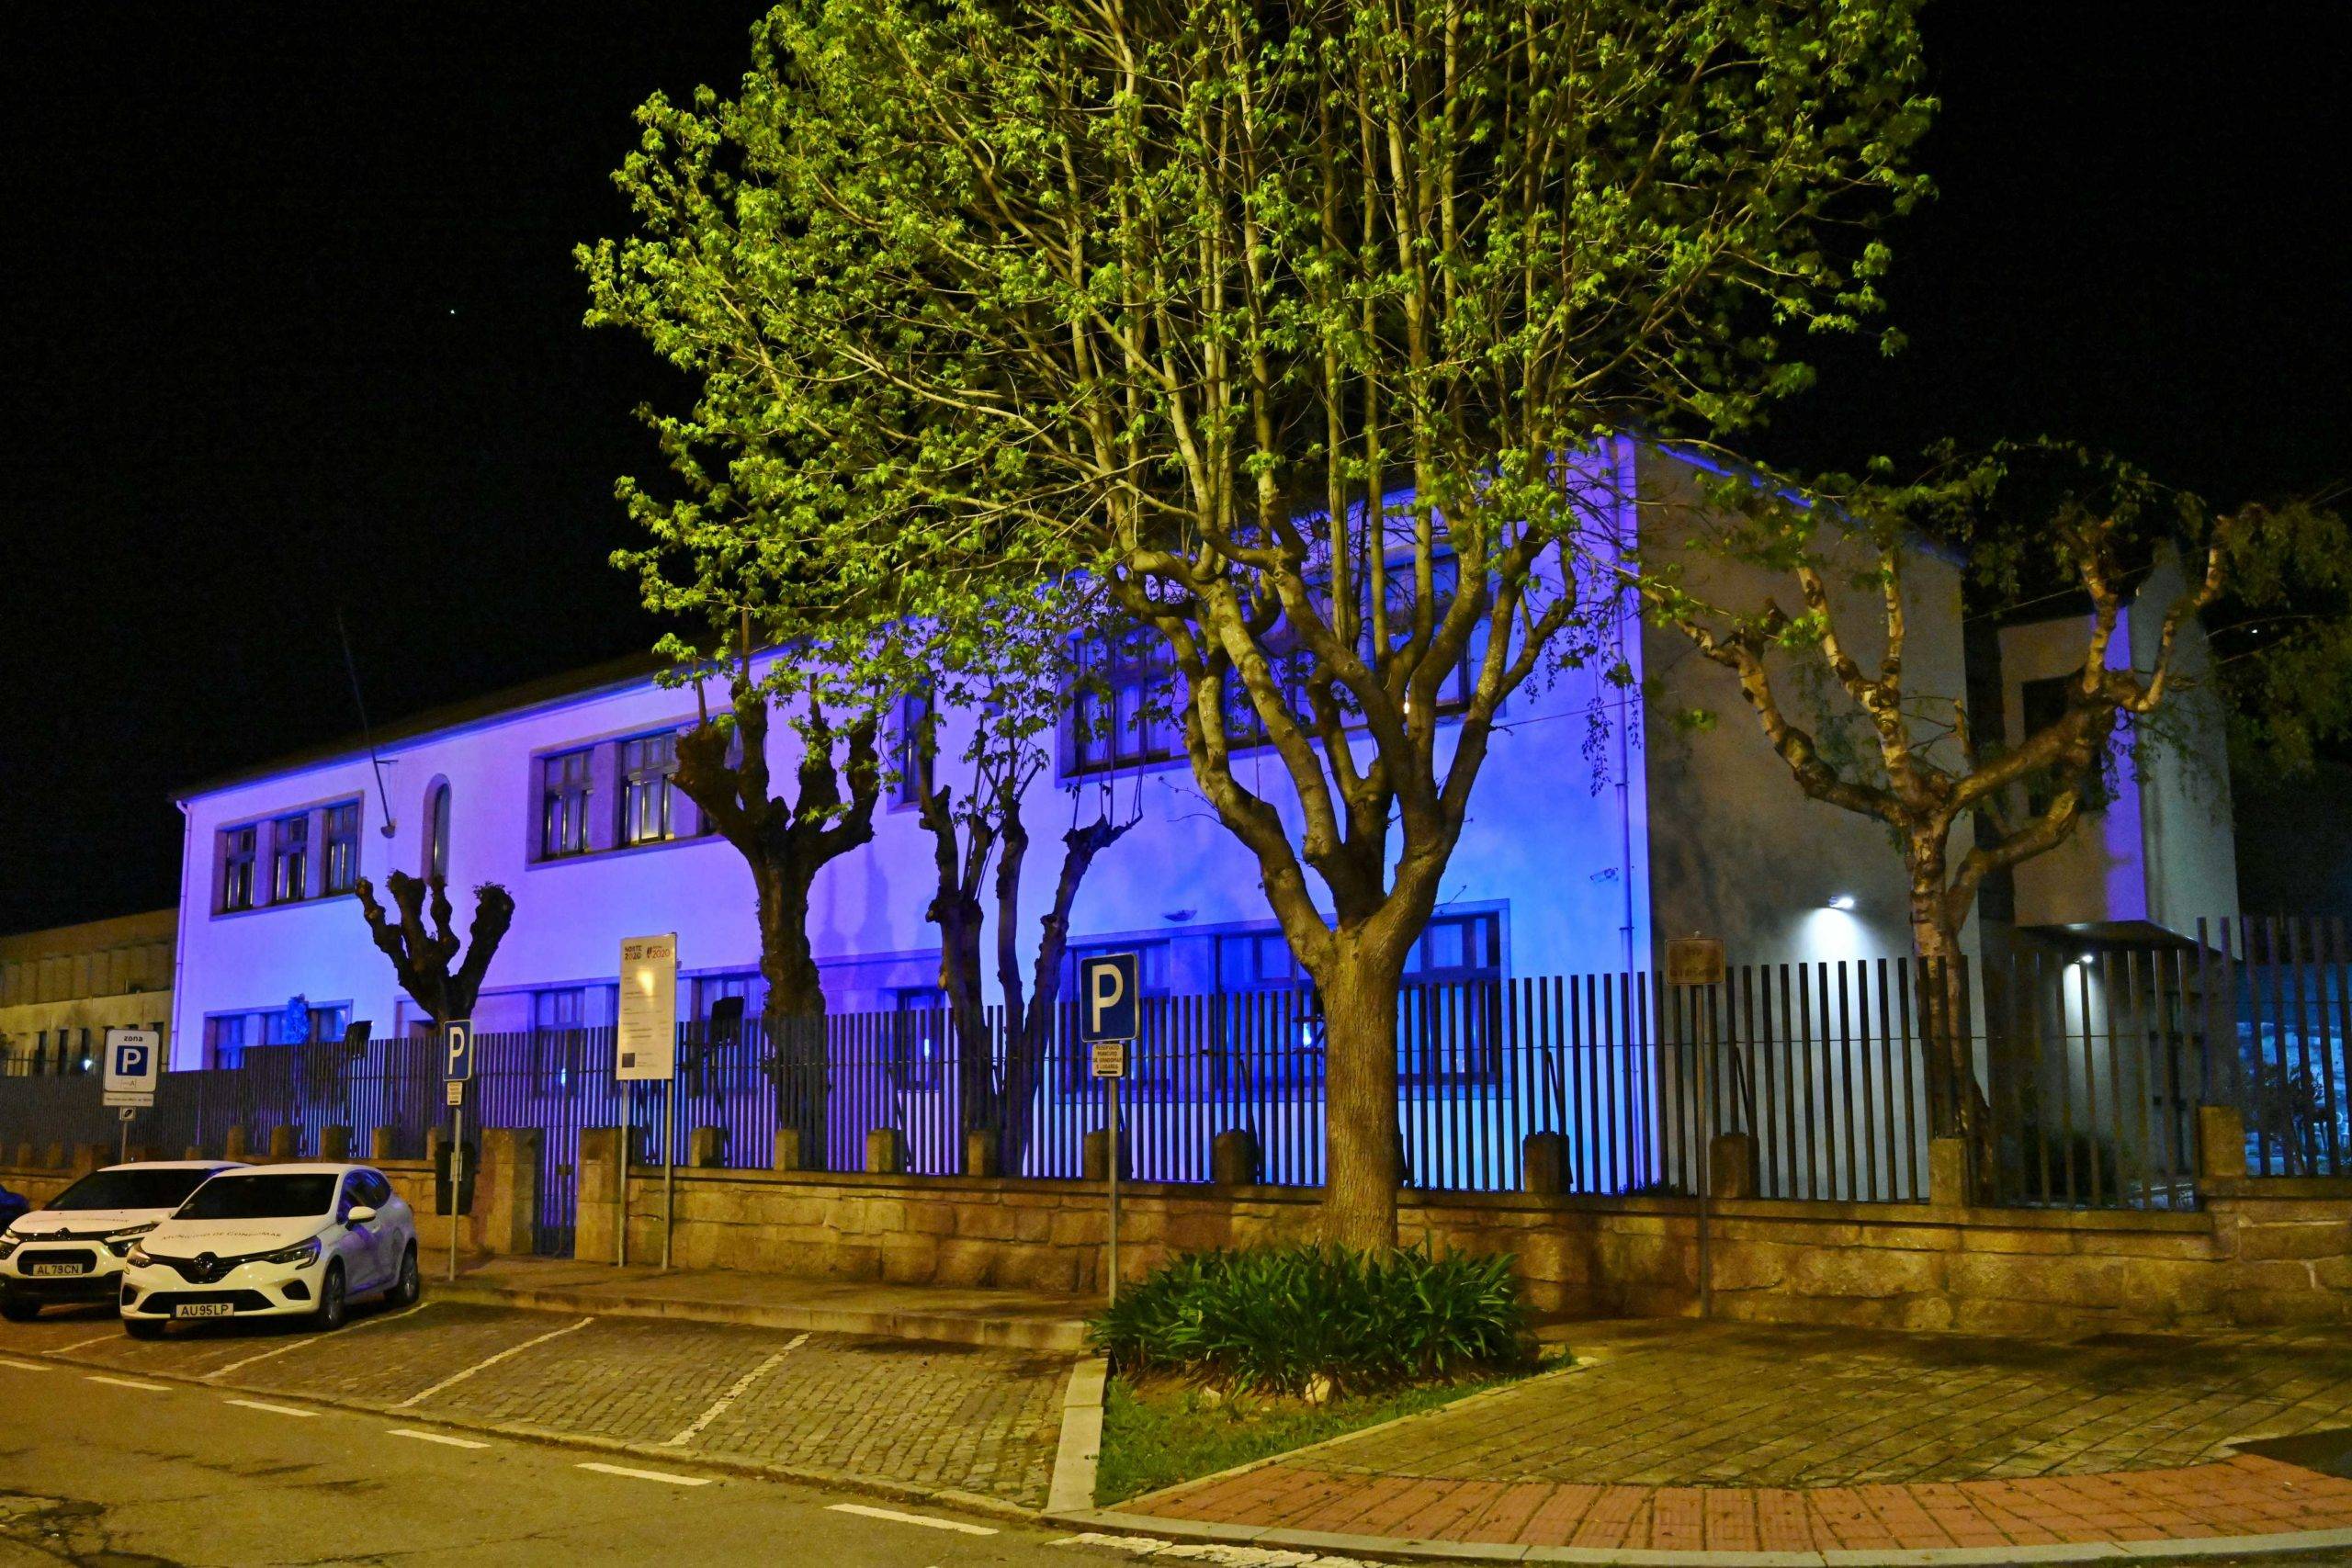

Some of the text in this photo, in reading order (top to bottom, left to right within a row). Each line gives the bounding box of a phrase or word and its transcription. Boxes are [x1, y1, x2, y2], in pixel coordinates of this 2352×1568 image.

[652, 948, 670, 959] 2020
[1091, 964, 1124, 1032] P
[122, 1048, 141, 1074] P
[448, 1026, 465, 1075] P
